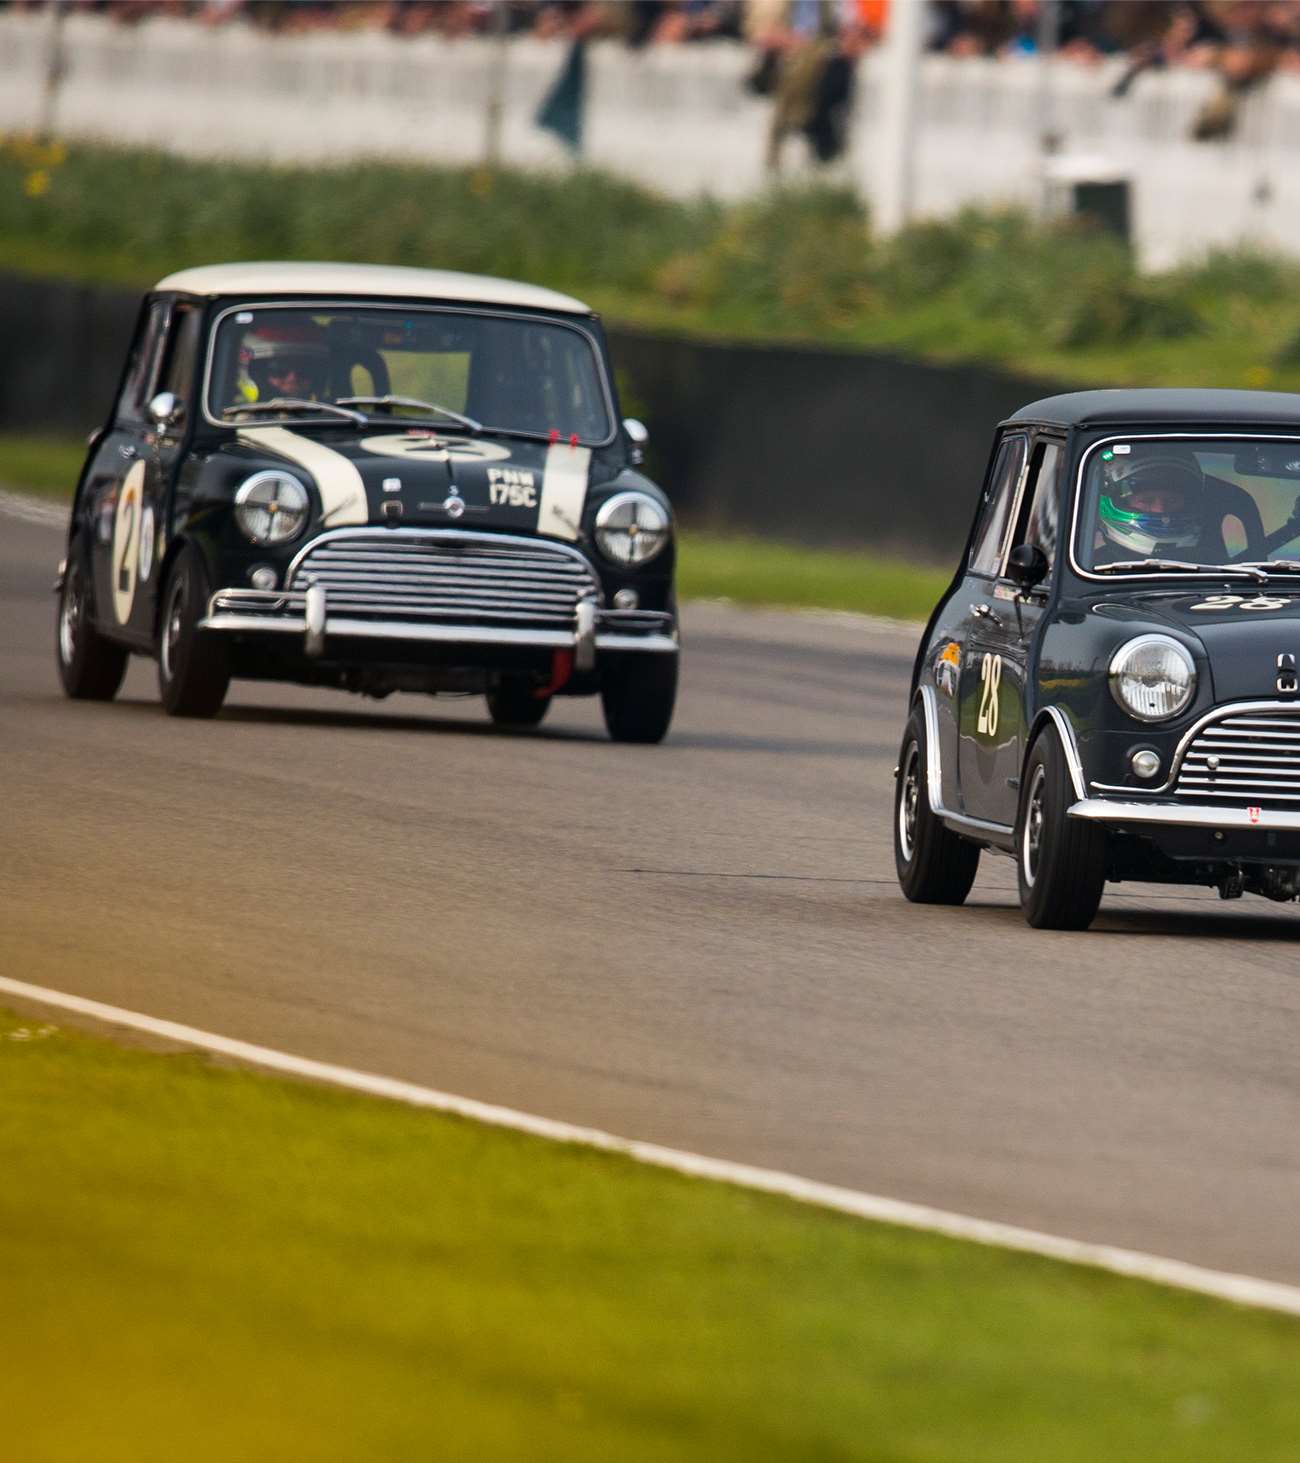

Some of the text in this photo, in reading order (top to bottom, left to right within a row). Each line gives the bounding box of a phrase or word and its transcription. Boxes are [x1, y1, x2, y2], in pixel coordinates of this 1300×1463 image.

[490, 484, 537, 508] 175C
[119, 486, 135, 593] 2
[1190, 595, 1292, 610] 28
[977, 652, 1001, 737] 28
